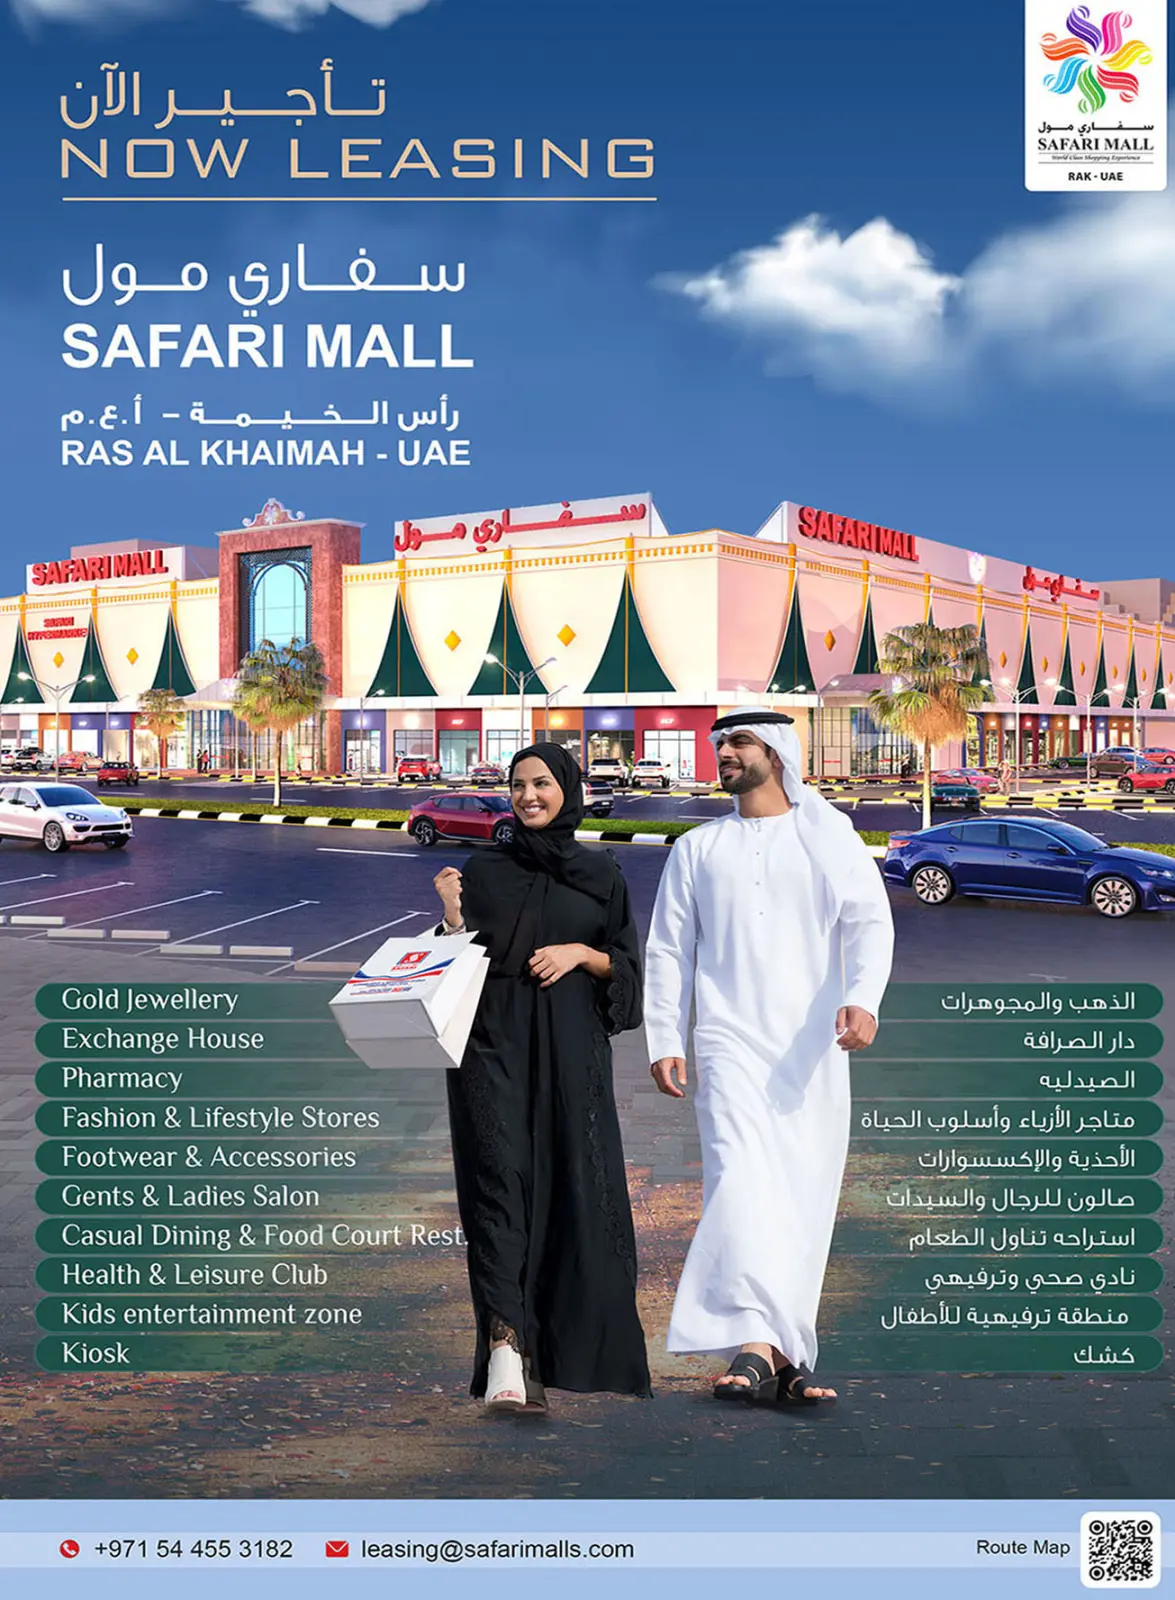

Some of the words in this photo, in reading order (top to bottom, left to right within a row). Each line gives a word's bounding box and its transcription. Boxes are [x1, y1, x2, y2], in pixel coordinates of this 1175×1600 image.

[394, 519, 467, 552] مول
[472, 500, 647, 552] سفاري
[797, 506, 879, 552] SAFARI
[879, 526, 920, 563] MALL
[32, 555, 112, 586] SAFARI
[113, 549, 169, 578] MALL
